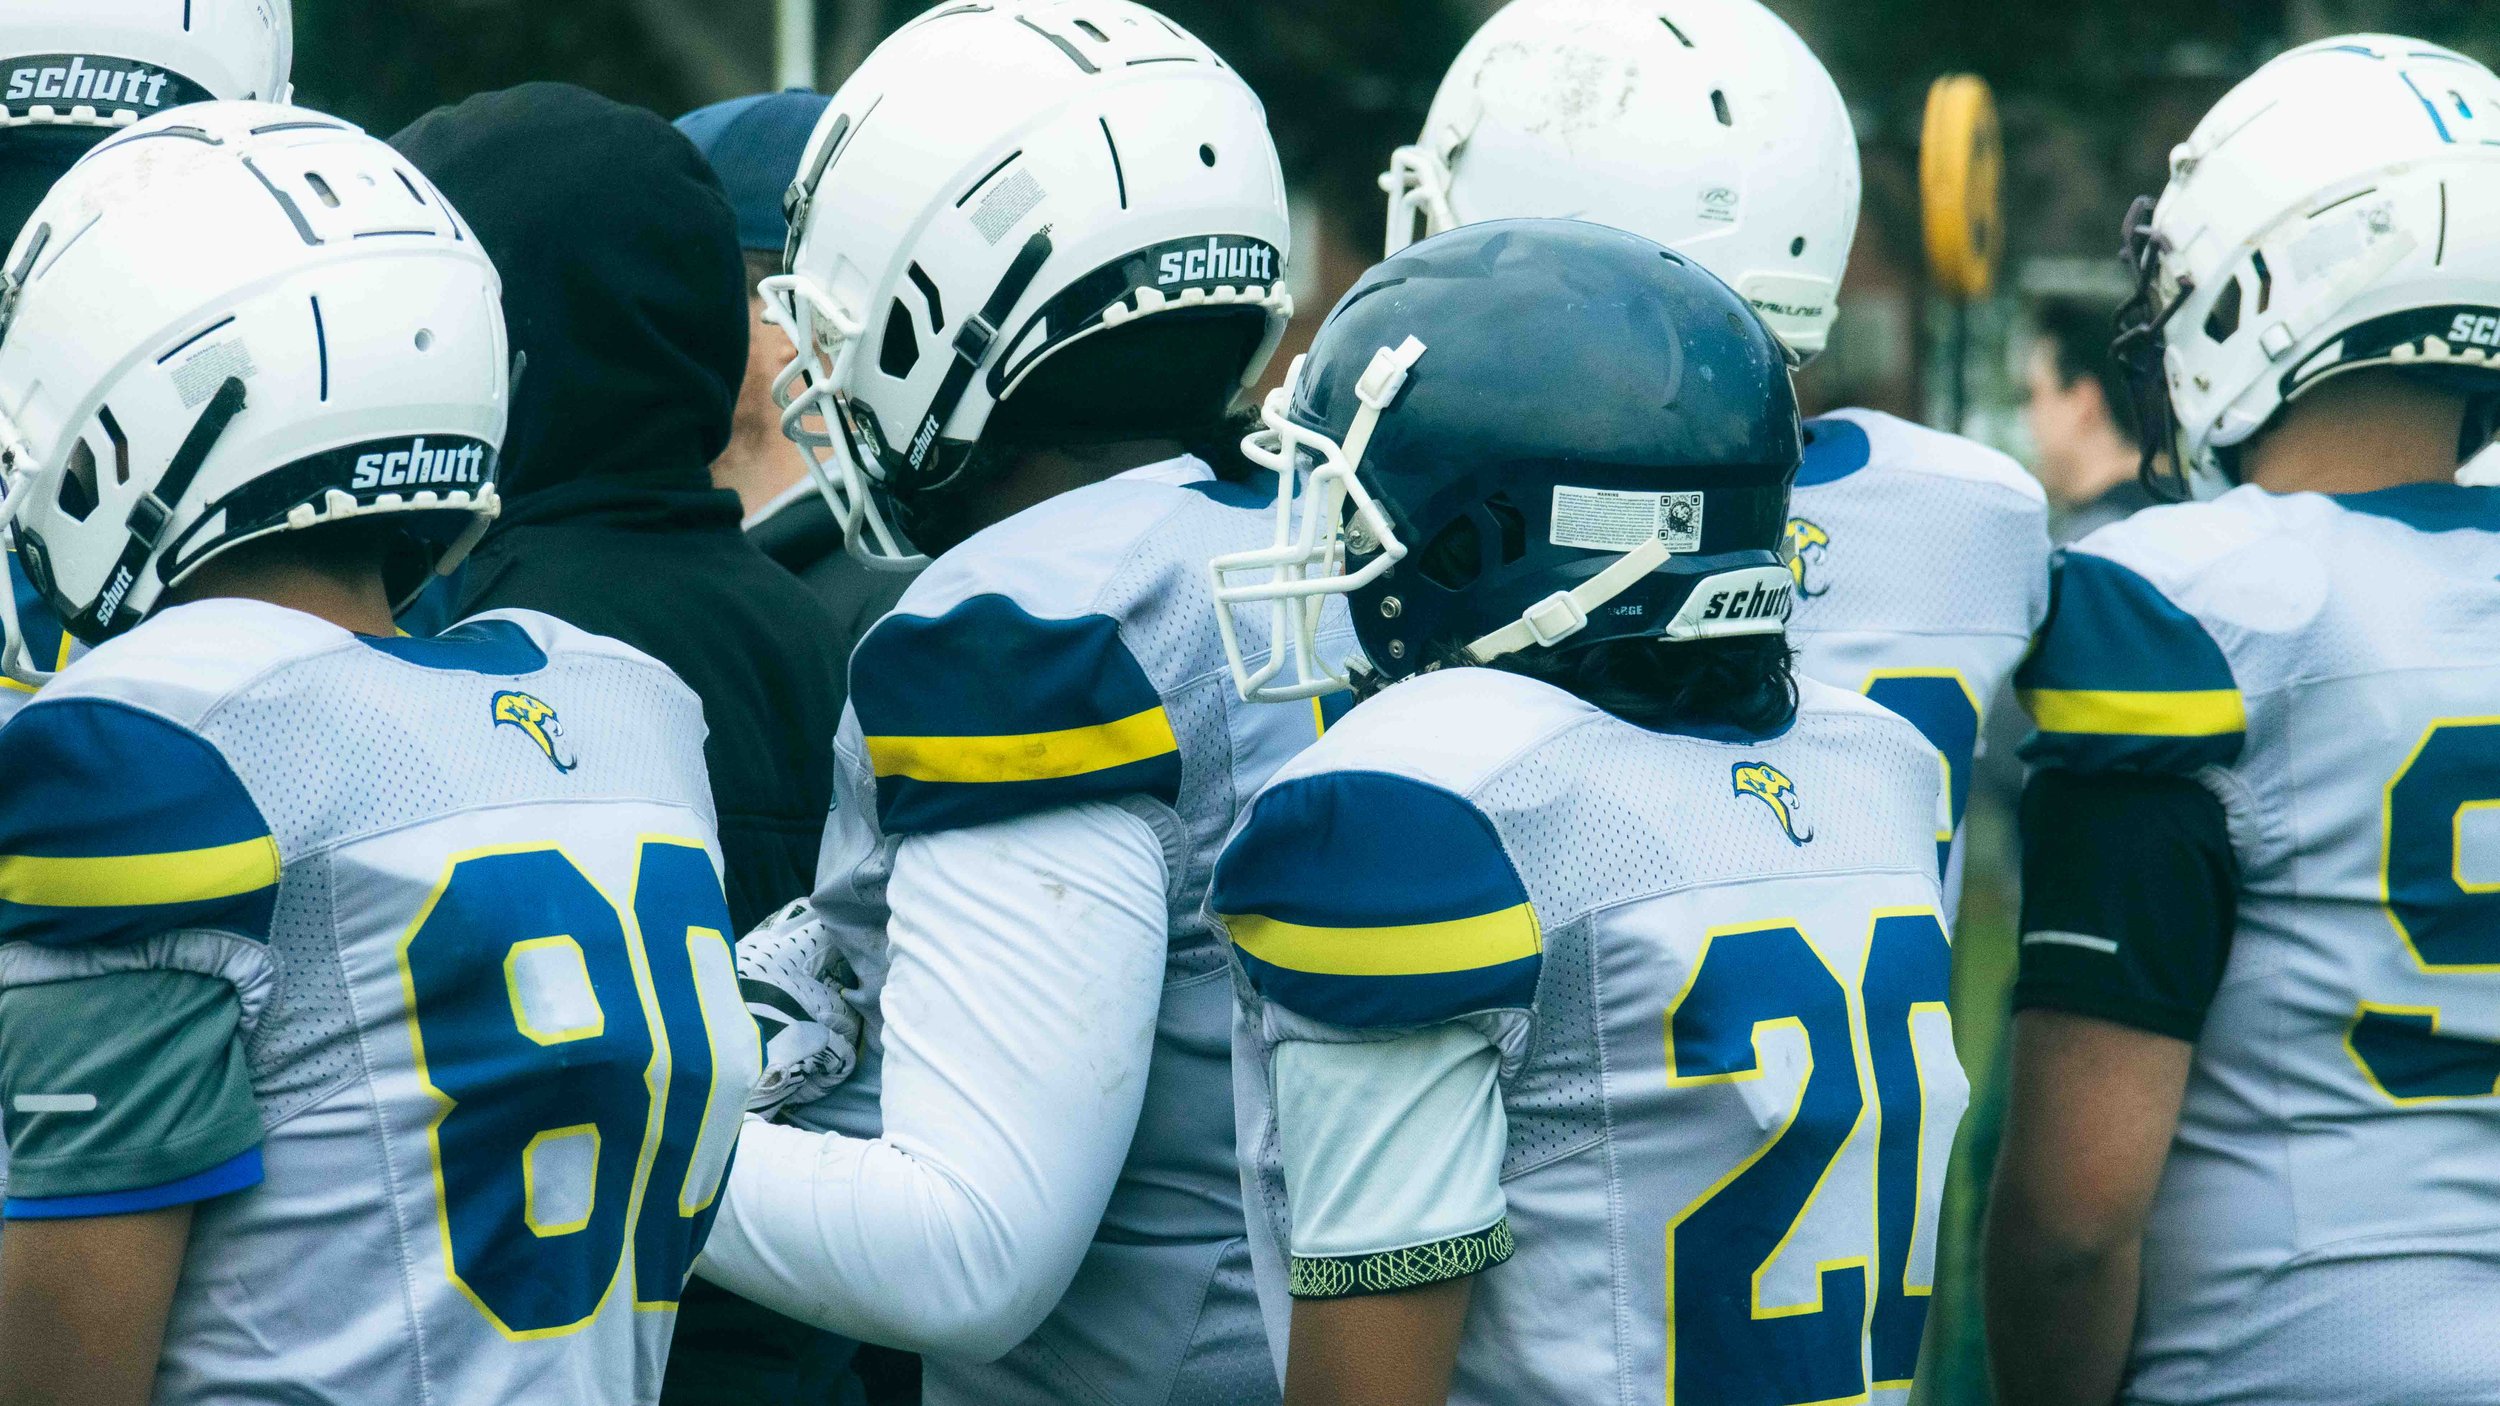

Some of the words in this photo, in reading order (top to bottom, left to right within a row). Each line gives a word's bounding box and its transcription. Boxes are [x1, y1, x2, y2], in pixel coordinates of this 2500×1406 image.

[5, 57, 168, 107] schutt
[1157, 237, 1272, 285] schutt
[351, 438, 484, 489] schutt
[908, 413, 940, 471] schutt
[96, 564, 134, 627] schutt
[398, 835, 767, 1341] 80
[1663, 905, 1958, 1406] 20
